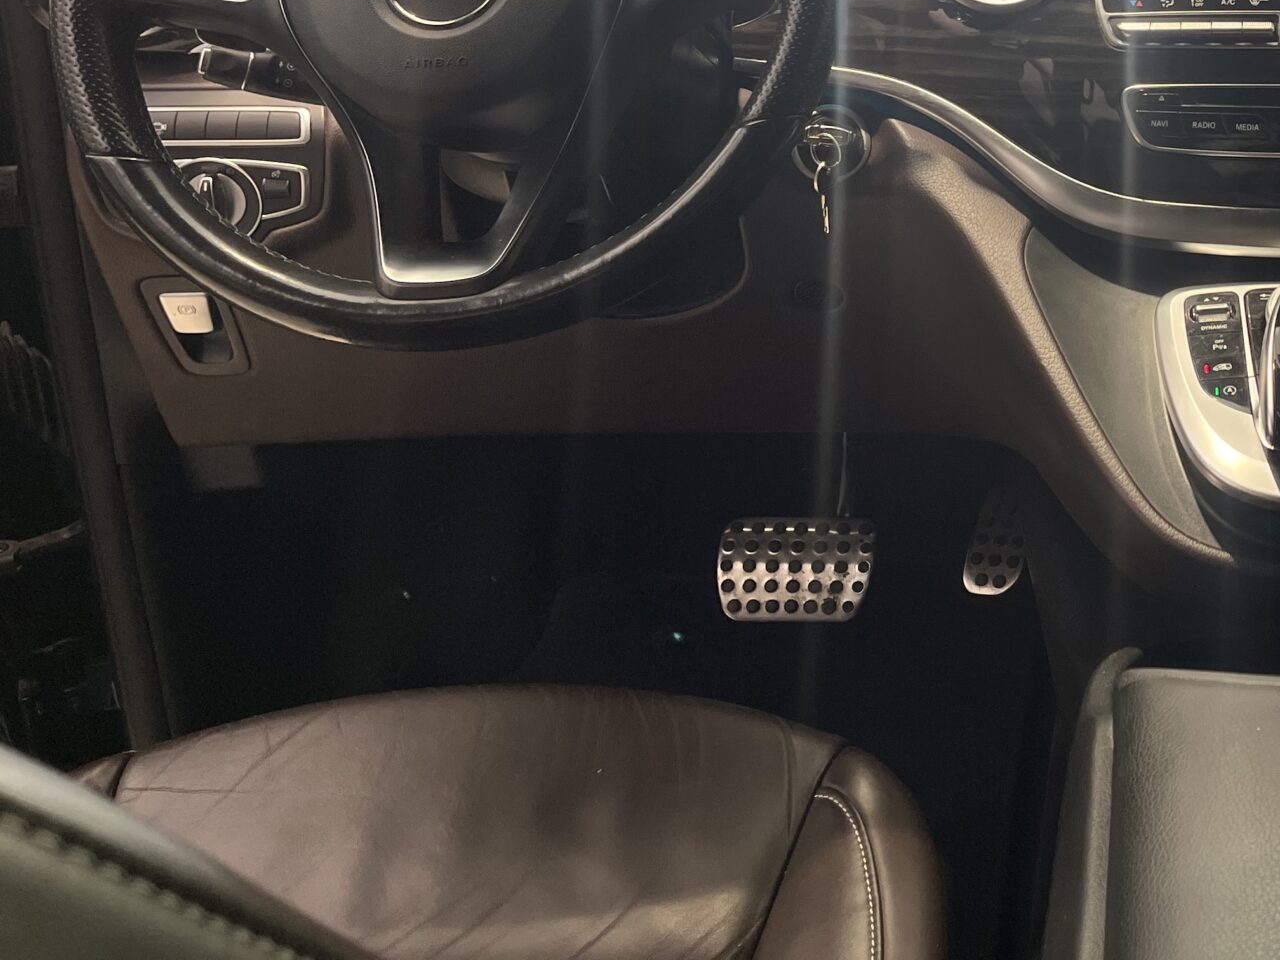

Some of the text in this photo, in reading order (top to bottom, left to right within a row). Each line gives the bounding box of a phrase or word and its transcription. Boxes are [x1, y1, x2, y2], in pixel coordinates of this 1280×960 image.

[404, 56, 469, 70] AIRBAG
[1150, 120, 1169, 128] NAVI
[1191, 121, 1216, 129] RADIO
[1235, 123, 1260, 131] MEDIA
[1200, 323, 1228, 331] DYNAMIC
